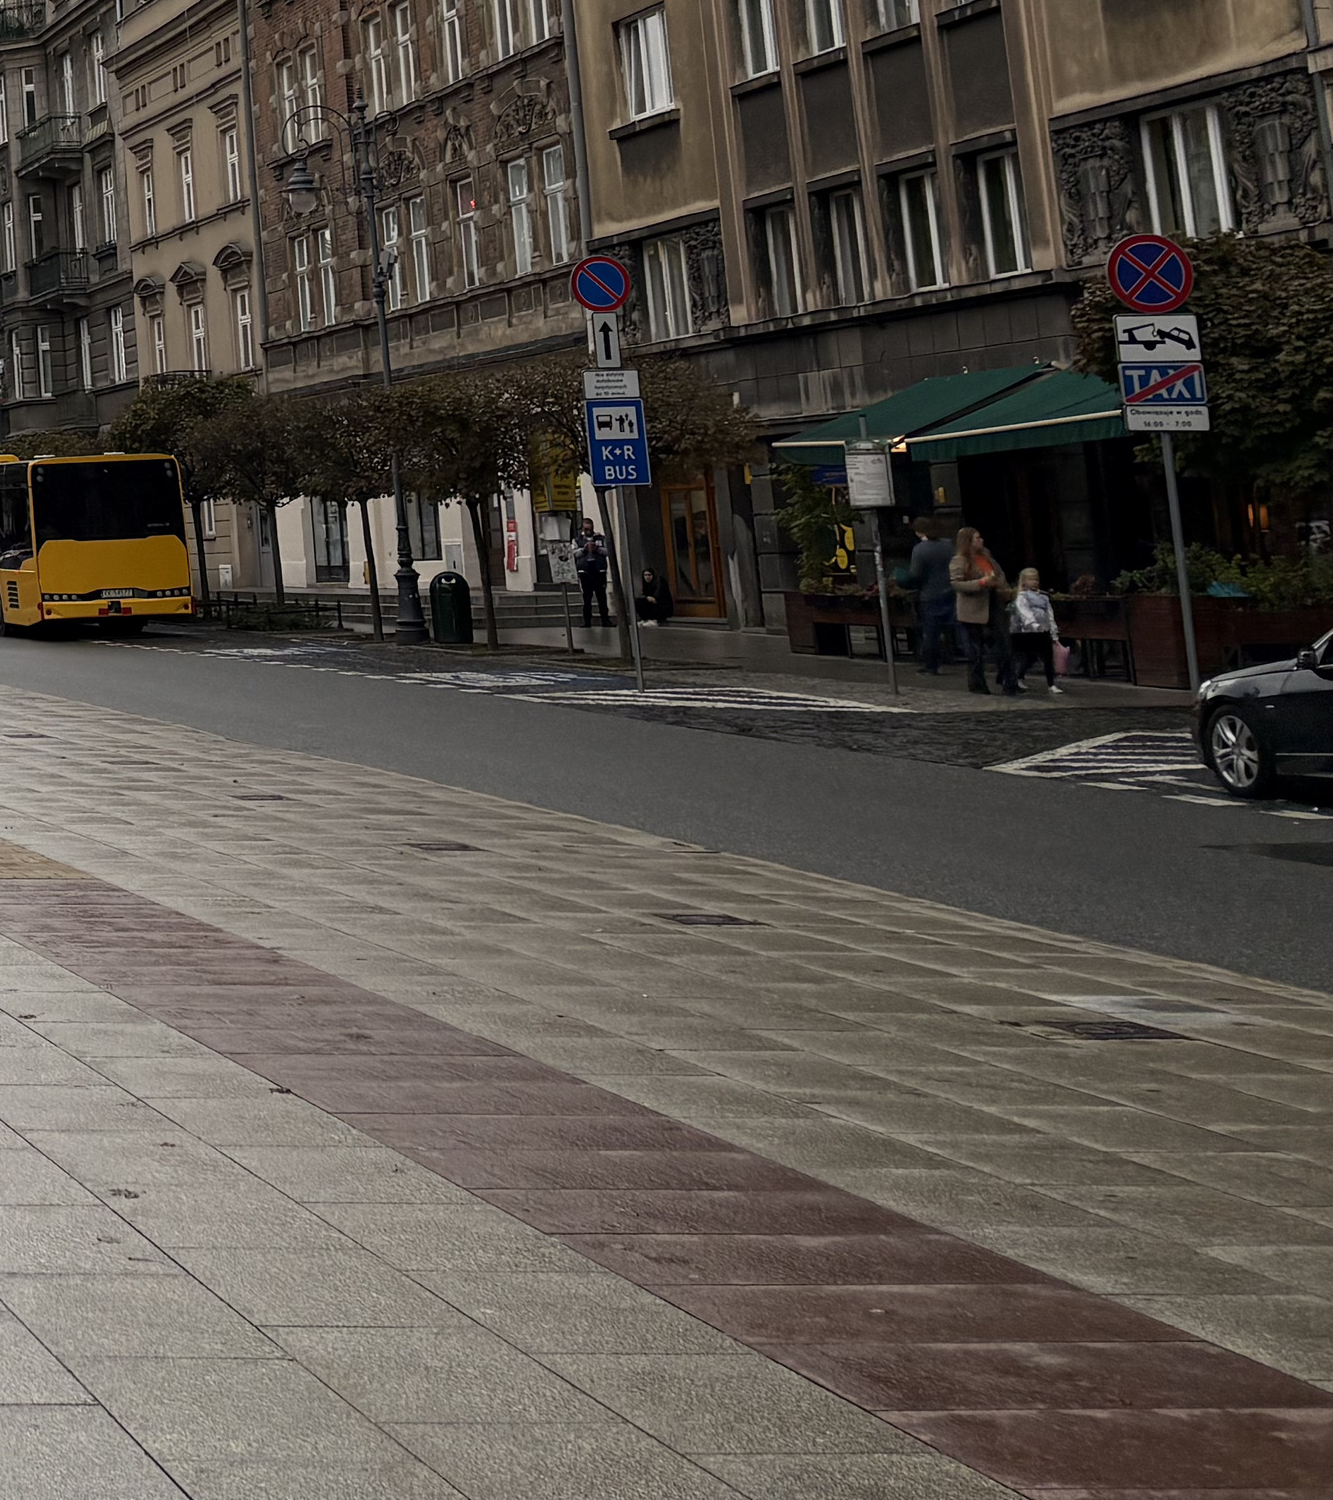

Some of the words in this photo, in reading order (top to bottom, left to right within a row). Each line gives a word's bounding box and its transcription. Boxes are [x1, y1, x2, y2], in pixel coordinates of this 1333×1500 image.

[1124, 369, 1203, 399] TAXI
[601, 445, 636, 461] K+R
[604, 465, 637, 480] BUS
